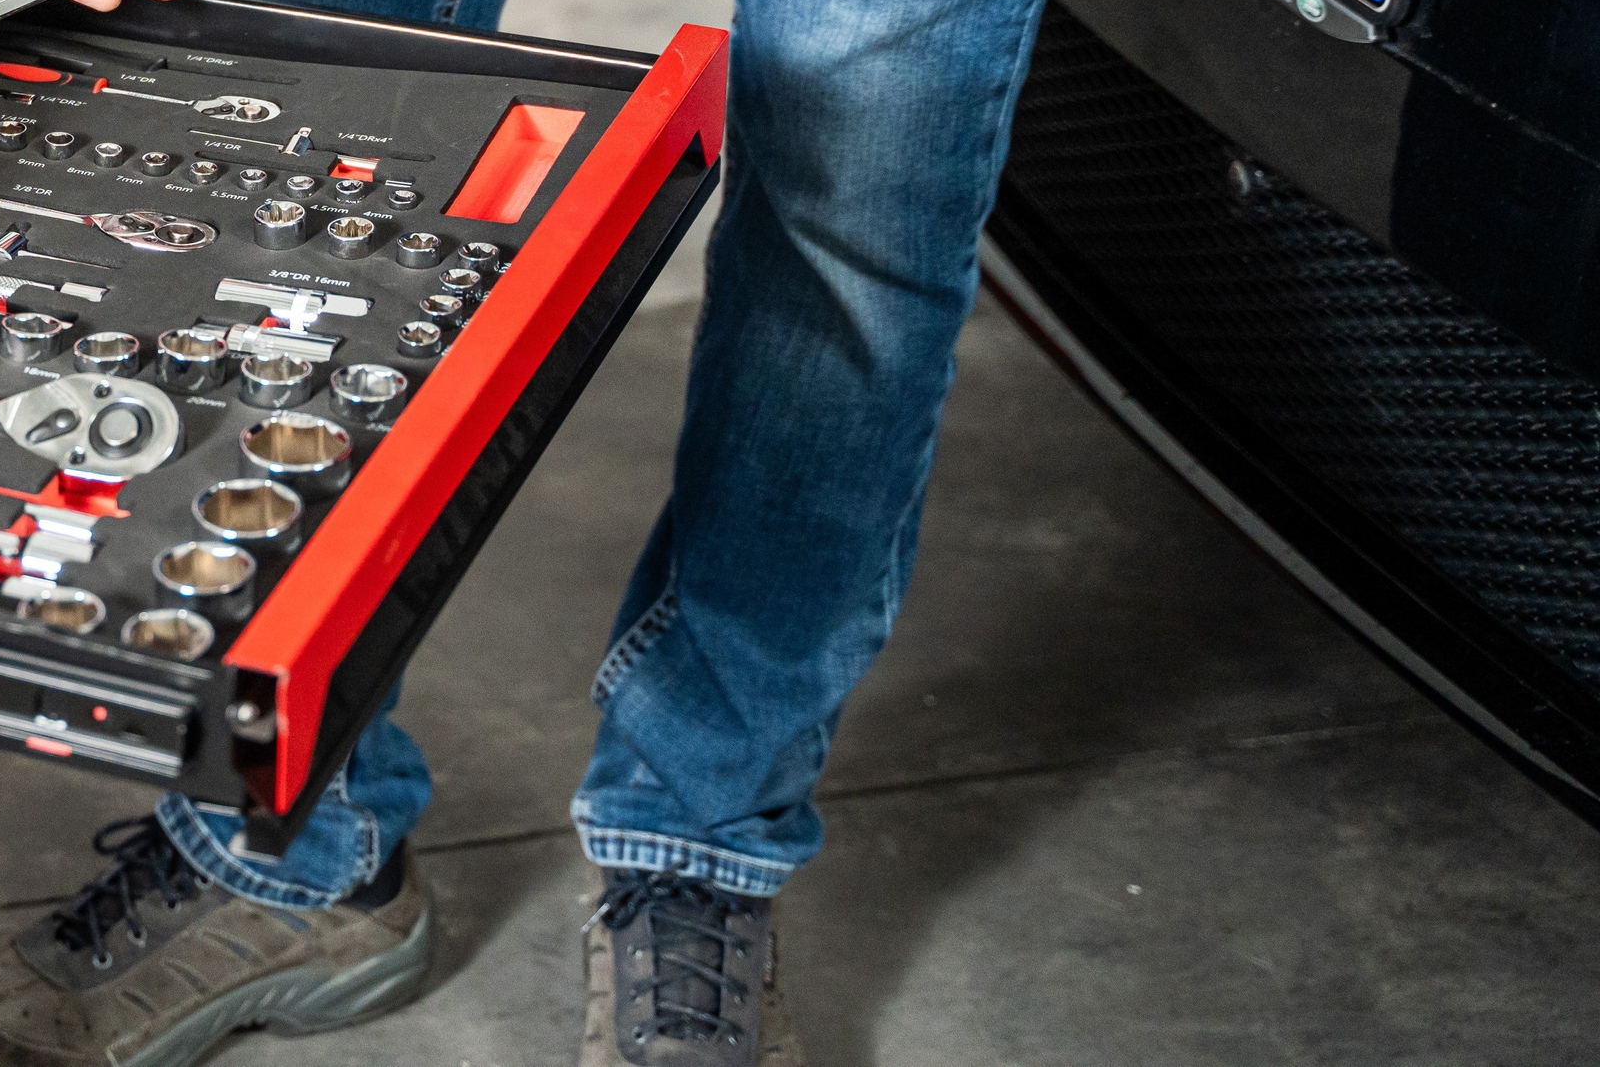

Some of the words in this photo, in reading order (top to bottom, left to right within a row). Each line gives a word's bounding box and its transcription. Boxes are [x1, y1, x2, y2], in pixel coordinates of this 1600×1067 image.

[120, 74, 156, 83] 1/4"DR
[0, 114, 37, 125] 1/4"DR
[338, 133, 392, 143] 1/4"DRx4"
[204, 141, 242, 151] 1/4"DR
[12, 184, 52, 196] 3/8"DR
[17, 159, 46, 168] 9mm
[66, 167, 95, 177] 8mm
[116, 175, 144, 185] 7mm
[165, 183, 194, 193] 6mm
[210, 191, 248, 201] 5.5mm
[310, 205, 349, 214] 4.5mm
[362, 211, 393, 219] 4mm
[268, 269, 310, 281] 3/8"DR
[314, 275, 350, 287] 16mm
